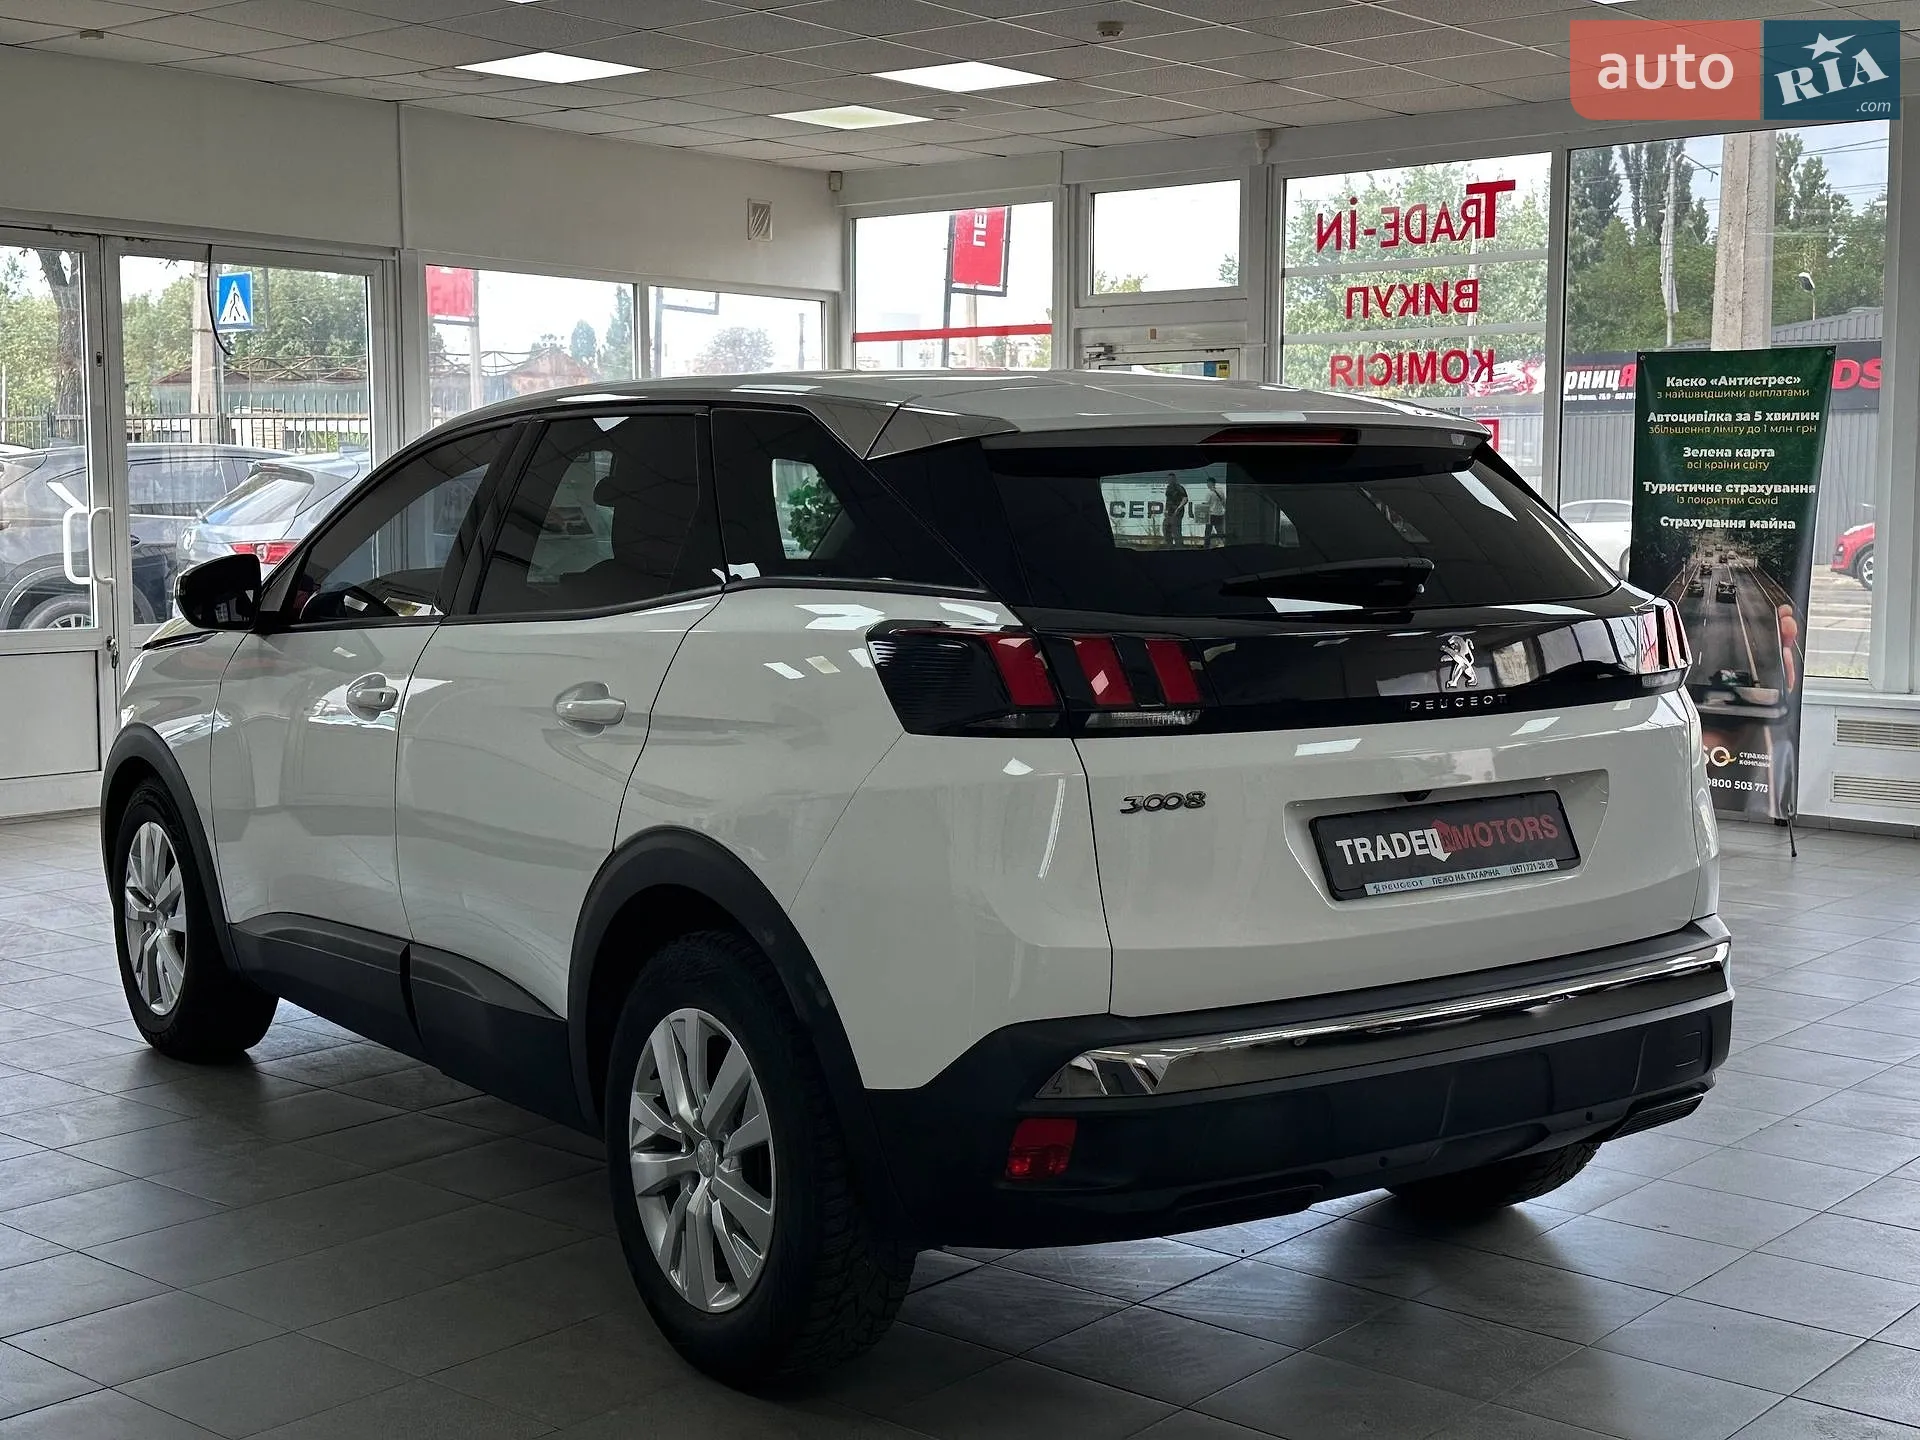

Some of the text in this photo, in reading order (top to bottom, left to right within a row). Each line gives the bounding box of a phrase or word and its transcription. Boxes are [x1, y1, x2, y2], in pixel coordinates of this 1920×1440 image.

[1666, 375, 1801, 388] Каско «Антистрес»
[1749, 388, 1810, 398] виплатами
[1647, 410, 1820, 424] Автоцивілка за 5 хвилин
[1649, 425, 1710, 434] збільшення
[1712, 425, 1745, 435] ліміту
[1746, 426, 1761, 435] до
[1683, 447, 1775, 459] Зелена карта
[1743, 460, 1770, 472] світу
[1642, 482, 1817, 495] Туристичне страхування
[1687, 496, 1745, 506] покриттям
[1748, 496, 1778, 505] Covid
[1660, 516, 1796, 530] Страхування майна
[1410, 694, 1506, 710] PEUGEOT
[1734, 781, 1752, 791] 503
[1120, 791, 1206, 814] 3008
[1450, 814, 1559, 851] MOTORS
[1381, 880, 1423, 892] PEUGEOT
